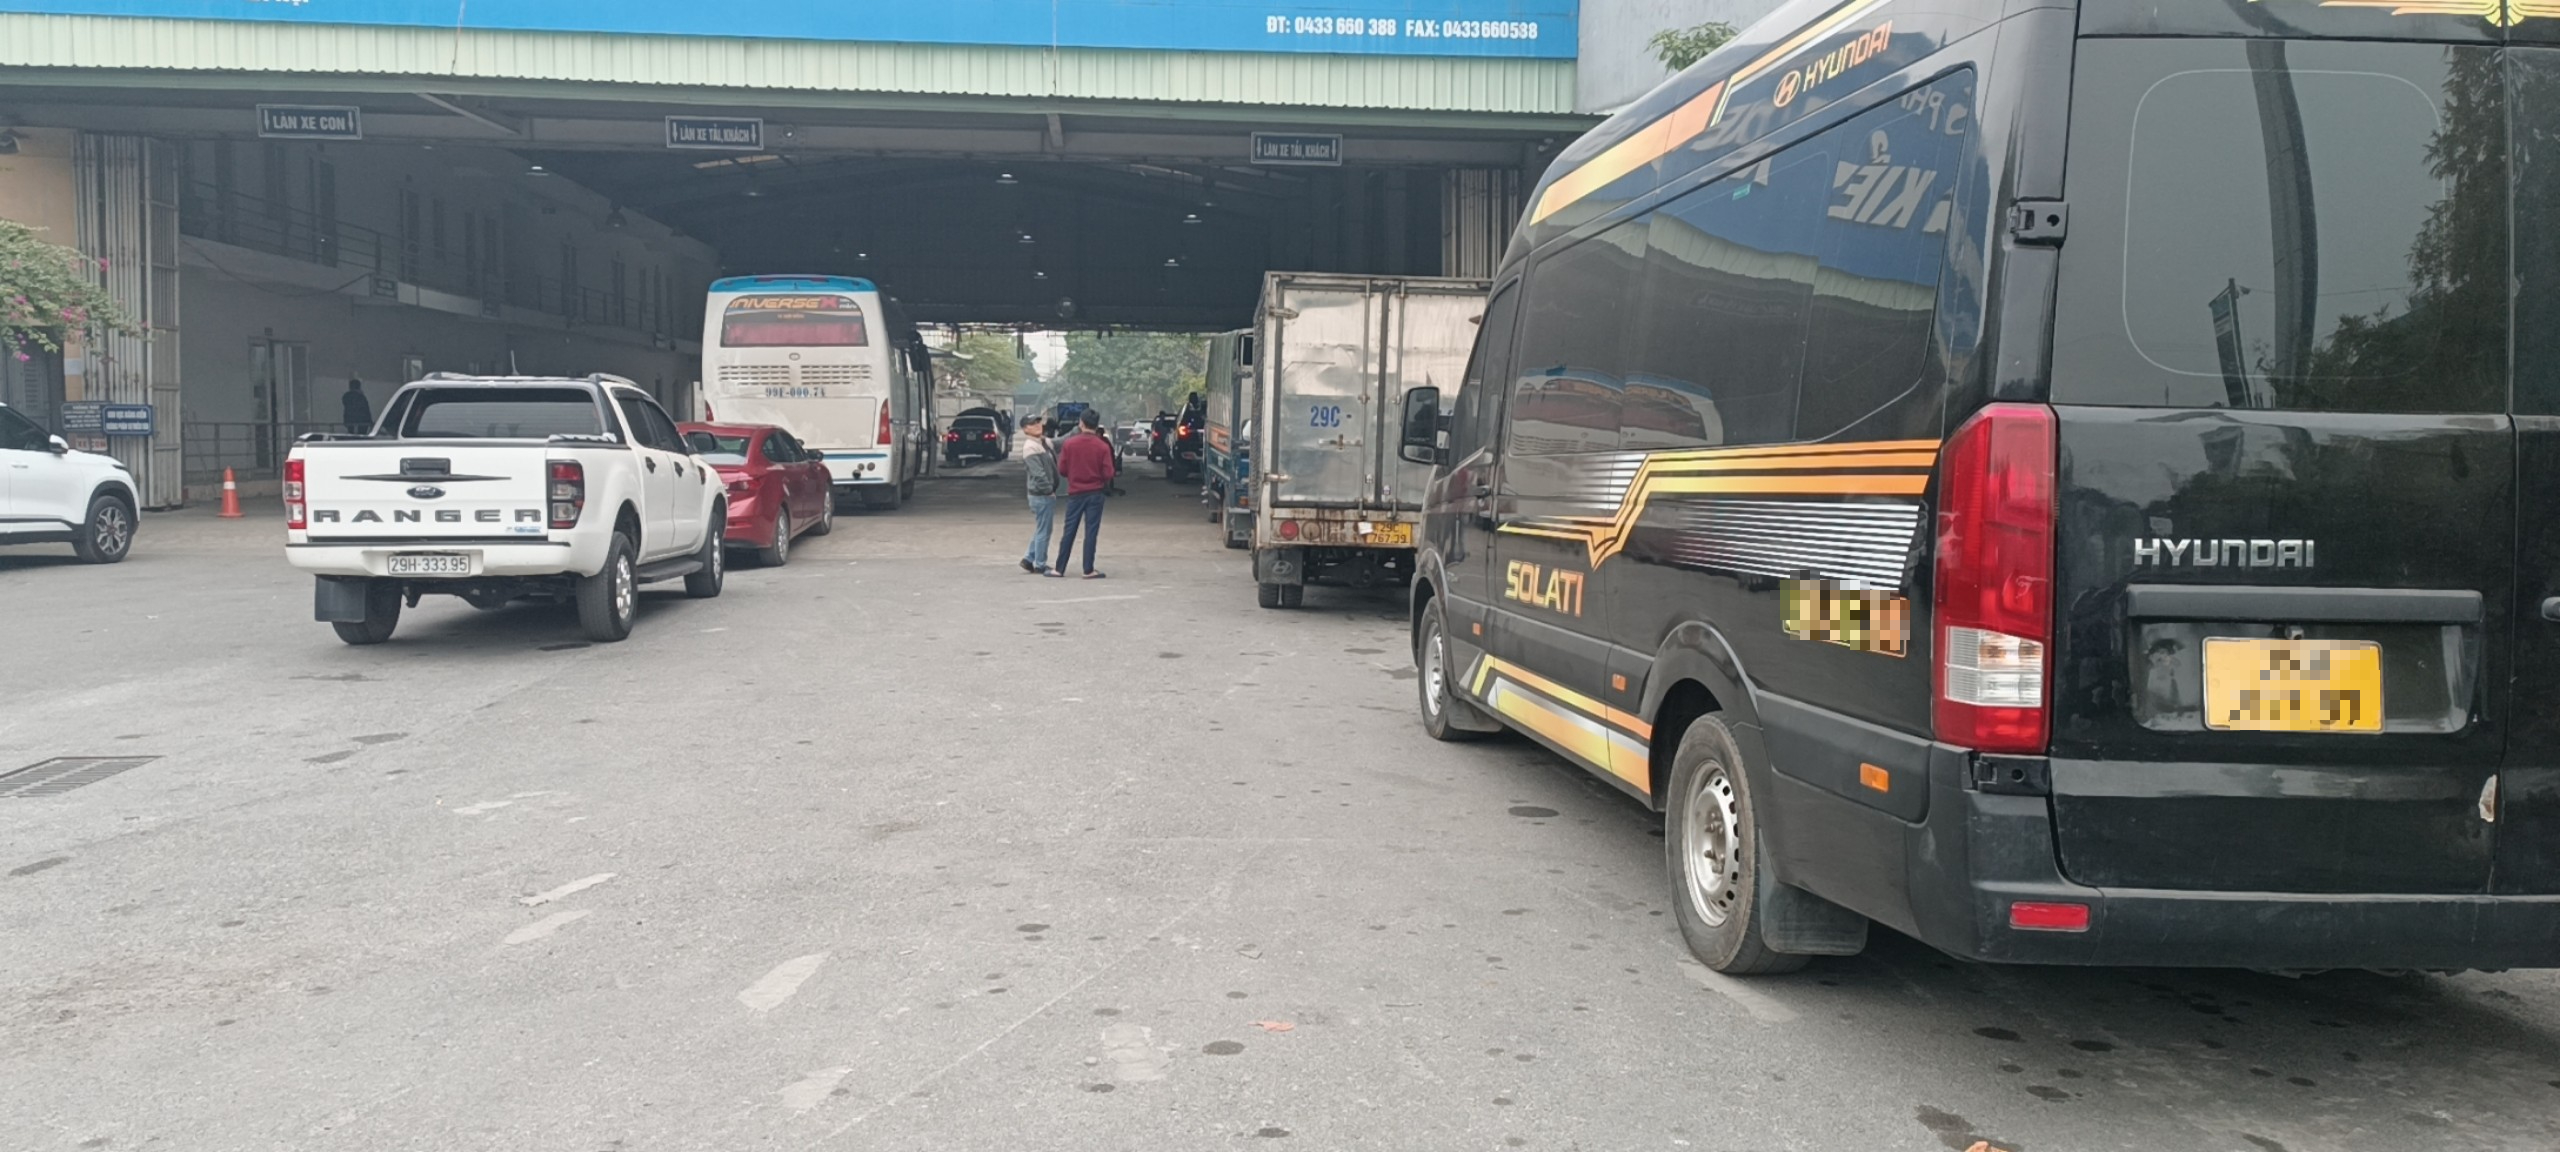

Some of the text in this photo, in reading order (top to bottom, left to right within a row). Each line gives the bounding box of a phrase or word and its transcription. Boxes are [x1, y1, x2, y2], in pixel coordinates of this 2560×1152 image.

[1295, 16, 1333, 34] 0433
[1336, 17, 1364, 35] 660
[1368, 18, 1397, 36] 388
[1405, 19, 1440, 37] FAX:
[1803, 19, 1893, 93] HYUNDAI
[301, 115, 317, 130] XE
[319, 116, 346, 131] CON
[697, 127, 707, 141] XE
[1280, 144, 1289, 157] XE
[1310, 405, 1340, 428] 29C
[313, 509, 542, 523] RANGER
[2133, 537, 2315, 568] HYUNDAI
[390, 558, 468, 572] 29H-333.95
[1504, 559, 1584, 618] SOLATI
